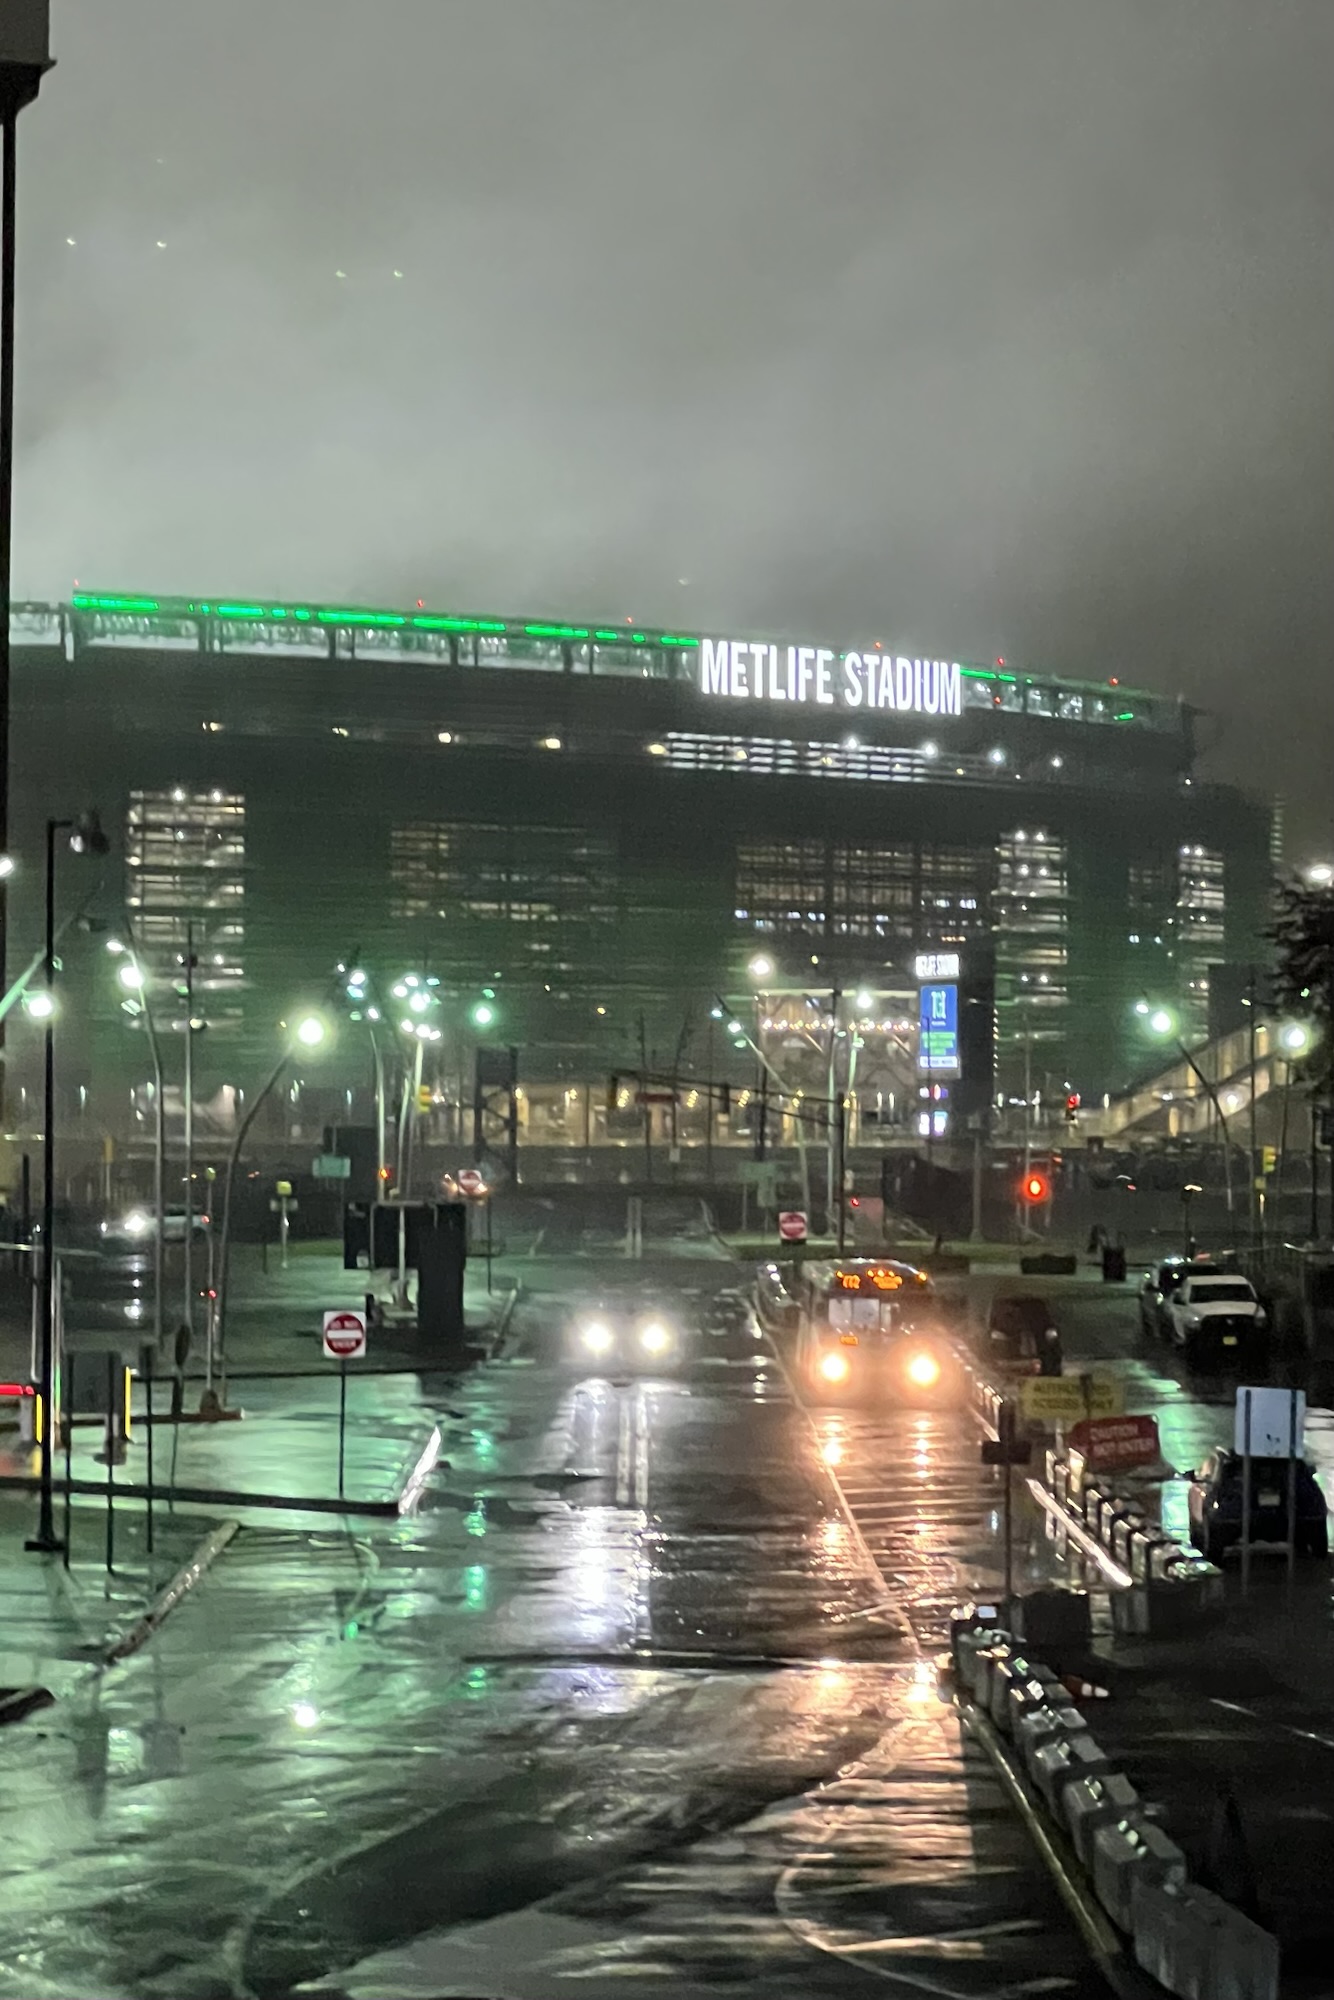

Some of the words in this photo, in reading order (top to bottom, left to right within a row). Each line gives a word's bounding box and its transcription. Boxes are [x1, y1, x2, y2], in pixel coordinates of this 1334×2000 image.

[701, 638, 834, 704] METLIFE
[844, 652, 962, 716] STADIUM
[1033, 1383, 1111, 1395] AUTHORED
[1085, 1398, 1114, 1410] NLY
